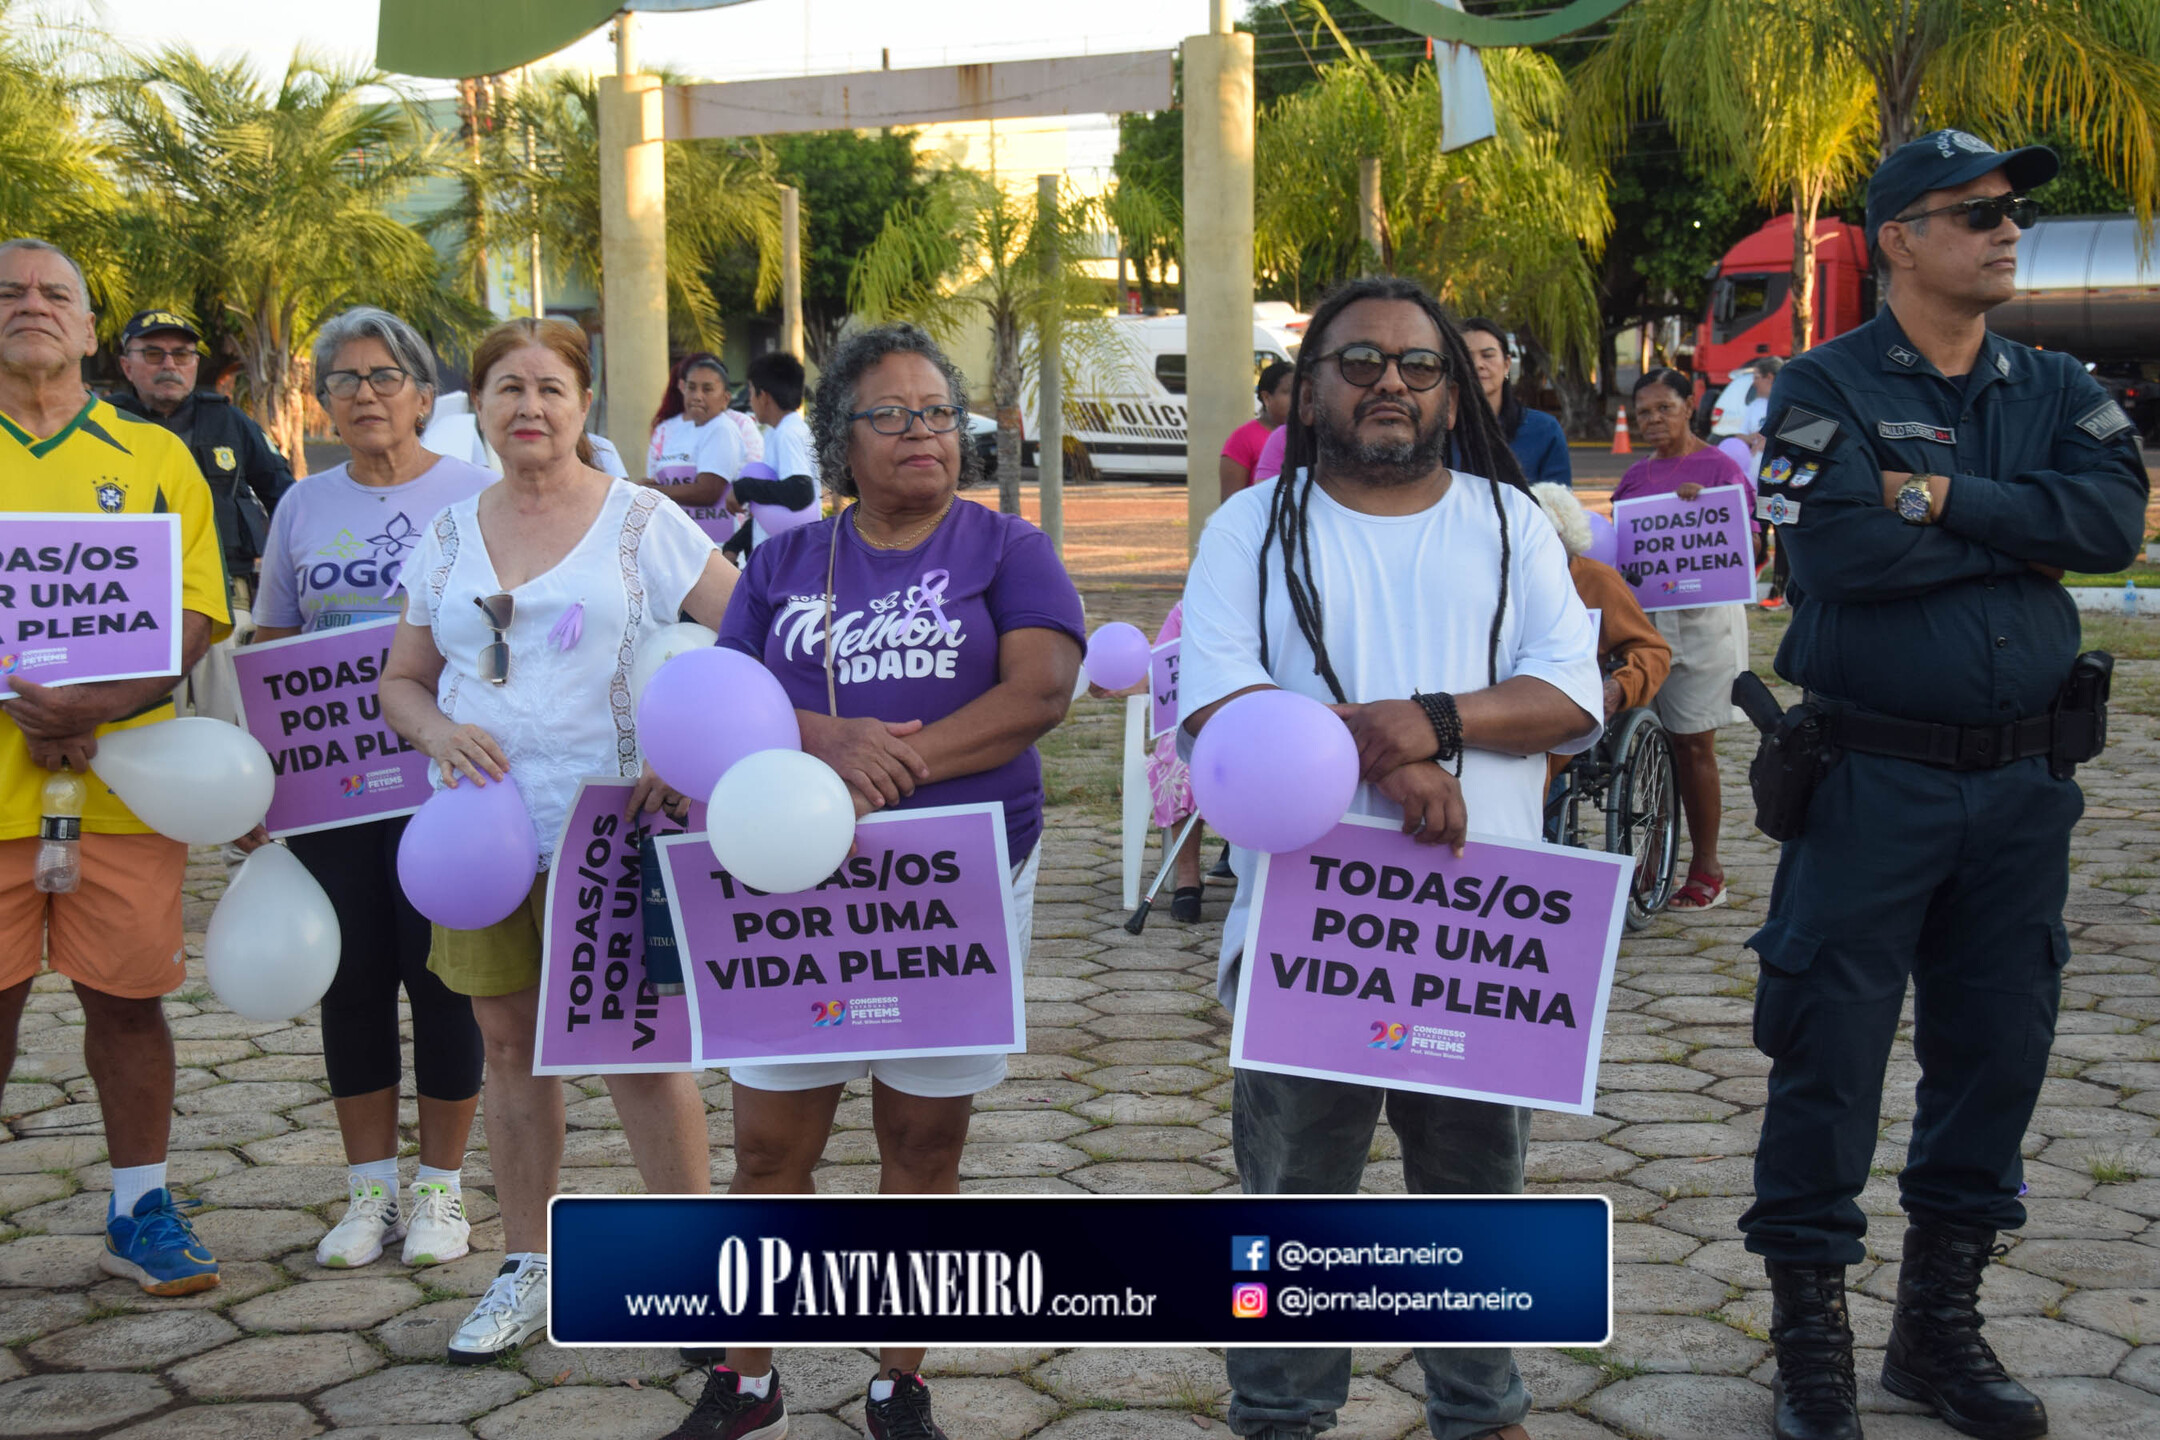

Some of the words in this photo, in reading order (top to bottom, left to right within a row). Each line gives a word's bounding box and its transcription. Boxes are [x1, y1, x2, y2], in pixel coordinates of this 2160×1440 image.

[1631, 507, 1730, 534] TODAS/OS
[0, 542, 139, 575] AS/OS
[1634, 536, 1675, 555] POR
[1681, 531, 1728, 550] UMA
[1676, 551, 1743, 573] PLENA
[31, 581, 130, 608] UMA
[18, 611, 159, 641] PLENA
[838, 649, 959, 685] IDADE
[280, 701, 350, 737] POR
[268, 740, 349, 776] VIDA
[612, 824, 651, 919] UMA
[711, 850, 960, 899] TAS/OS
[1309, 855, 1573, 925] TODAS/OS
[567, 813, 619, 1033] TODAS/OS
[733, 907, 834, 943] POR
[846, 899, 958, 934] UMA
[1311, 907, 1420, 955] POR
[1435, 924, 1550, 974] UMA
[601, 932, 634, 1020] POR
[706, 953, 828, 990] VIDA
[839, 943, 997, 982] PLENA
[849, 996, 899, 1006] CONGRESSO
[1270, 952, 1395, 1004] VIDA
[1411, 972, 1577, 1029] PLENA
[851, 1007, 901, 1019] FETEMS
[1411, 1036, 1465, 1053] FETEMS
[1413, 1025, 1466, 1038] CONGRESSO
